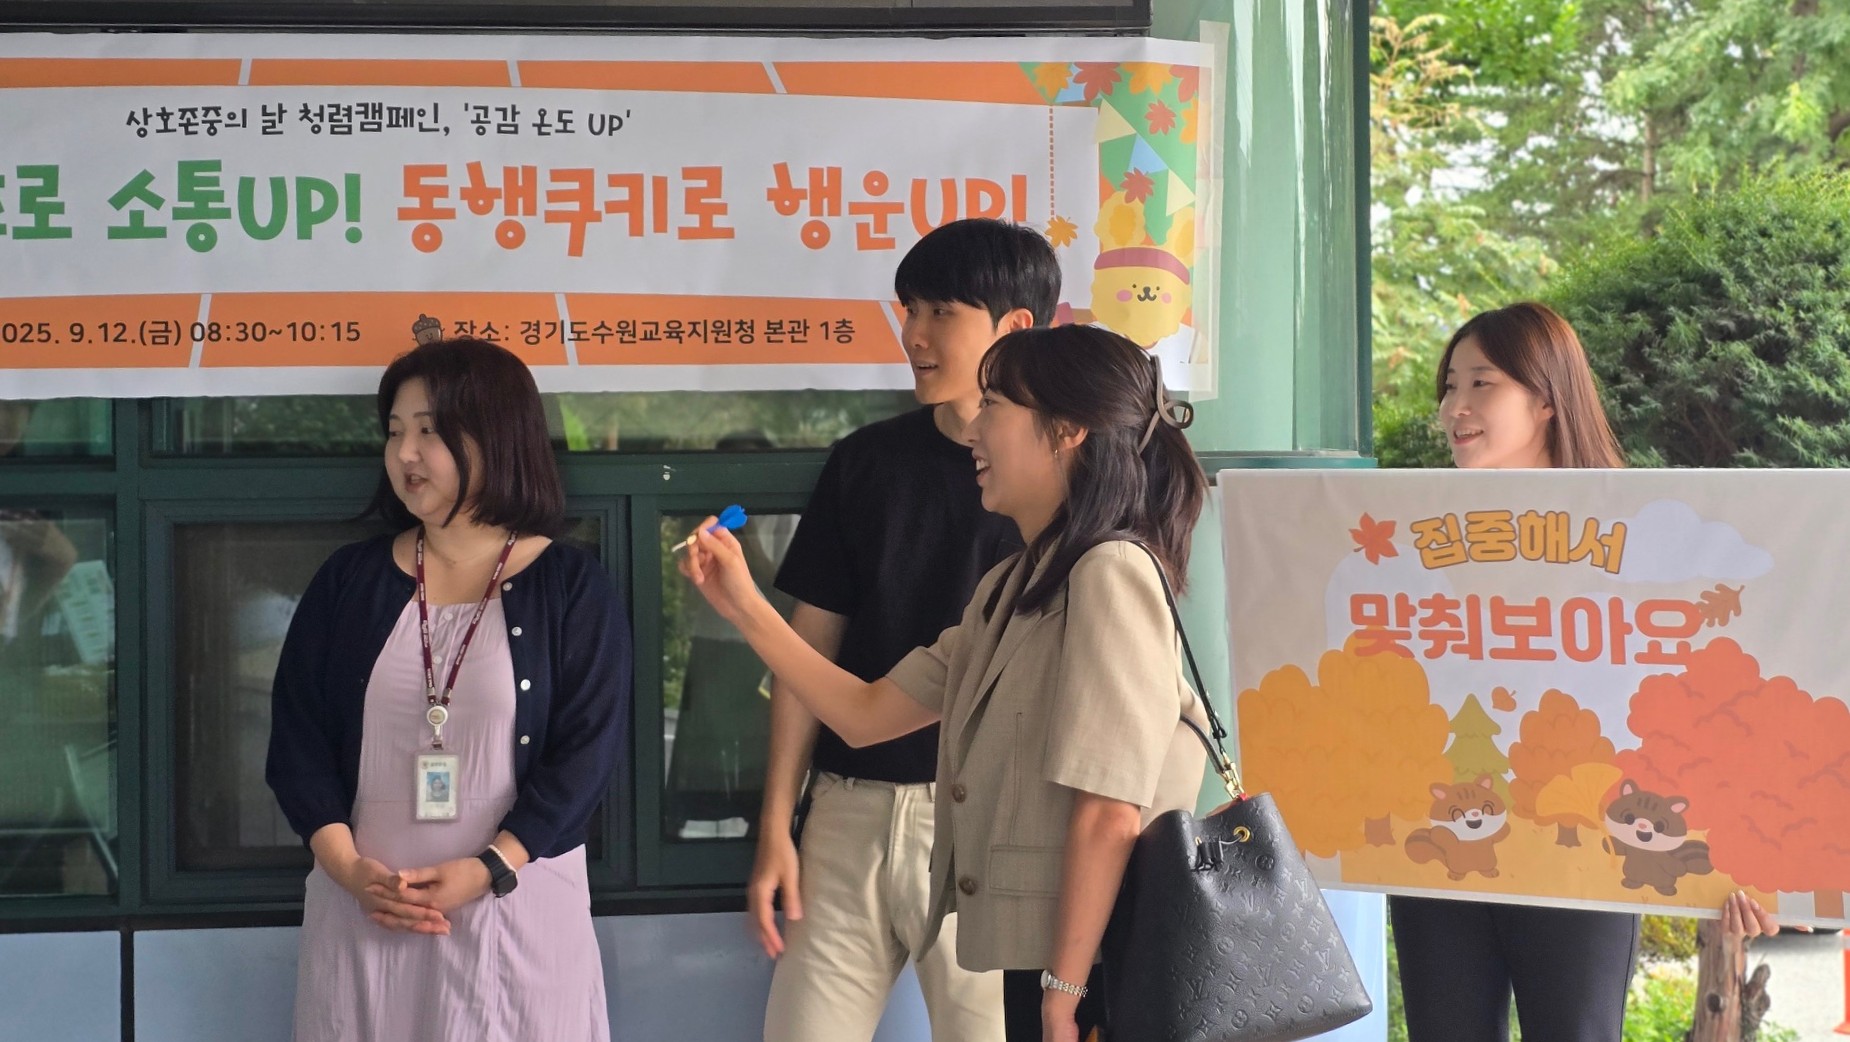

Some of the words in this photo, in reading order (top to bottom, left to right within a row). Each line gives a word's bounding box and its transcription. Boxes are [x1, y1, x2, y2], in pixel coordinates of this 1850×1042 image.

[126, 106, 247, 138] 상호존중의
[261, 102, 288, 136] 날
[298, 101, 450, 137] 청렴캠페인,
[464, 102, 521, 136] '공감
[532, 108, 576, 136] 온도
[588, 109, 631, 137] UP'
[0, 165, 72, 239] 로
[107, 159, 362, 252] 소통UP!
[397, 161, 735, 257] 동행쿠키로
[189, 321, 361, 343] 08:30~10:15
[519, 319, 755, 346] 경기도수원교육지원청
[763, 318, 811, 344] 본관
[819, 318, 856, 344] 1층
[1410, 509, 1628, 575] 집중해서
[1349, 592, 1704, 666] 맞춰보아요
